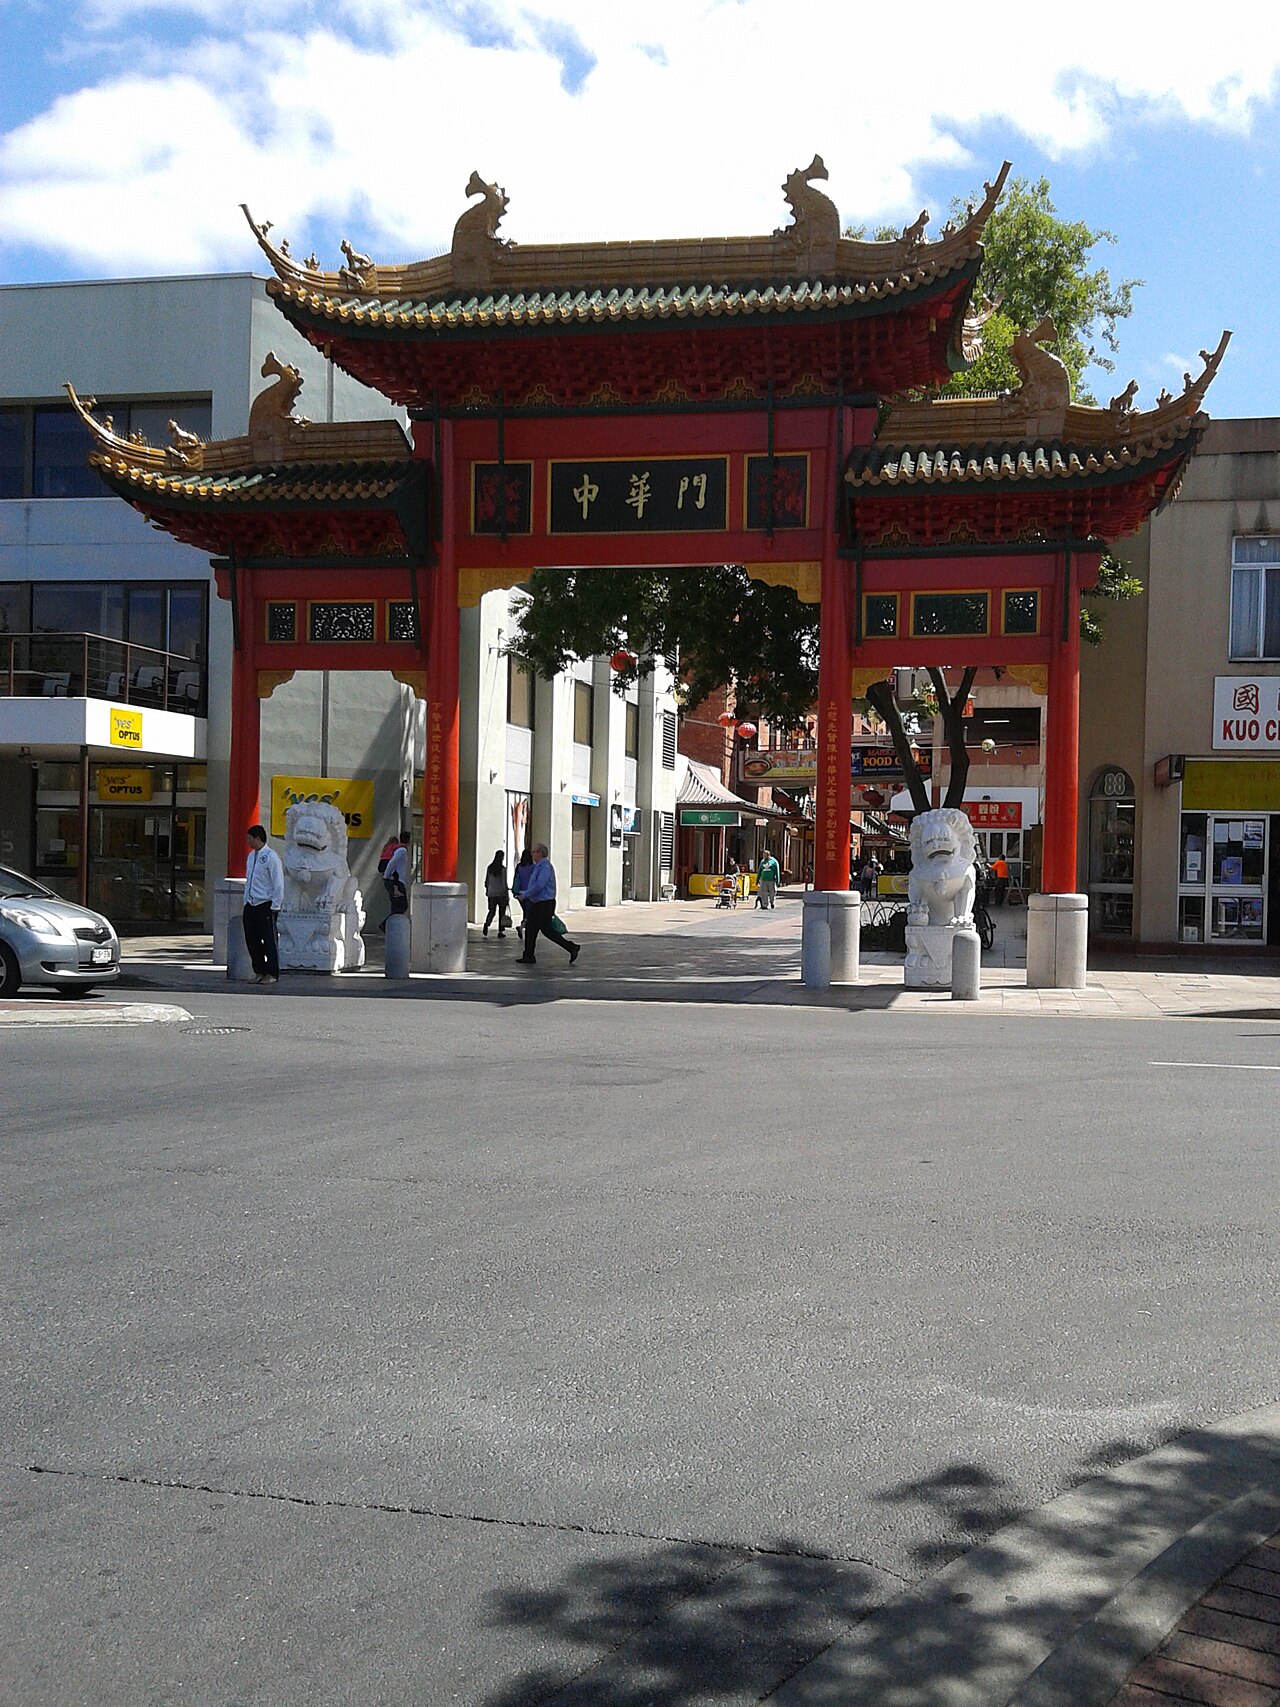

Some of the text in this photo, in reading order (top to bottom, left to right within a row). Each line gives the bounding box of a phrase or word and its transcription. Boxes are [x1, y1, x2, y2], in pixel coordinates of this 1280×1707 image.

[573, 472, 707, 520] 中華門
[1233, 684, 1259, 715] 國
[118, 730, 140, 741] OPTUS
[1223, 720, 1280, 741] KUO C
[863, 757, 892, 766] FOOD
[109, 786, 143, 794] OPTUS
[1104, 773, 1126, 796] 88
